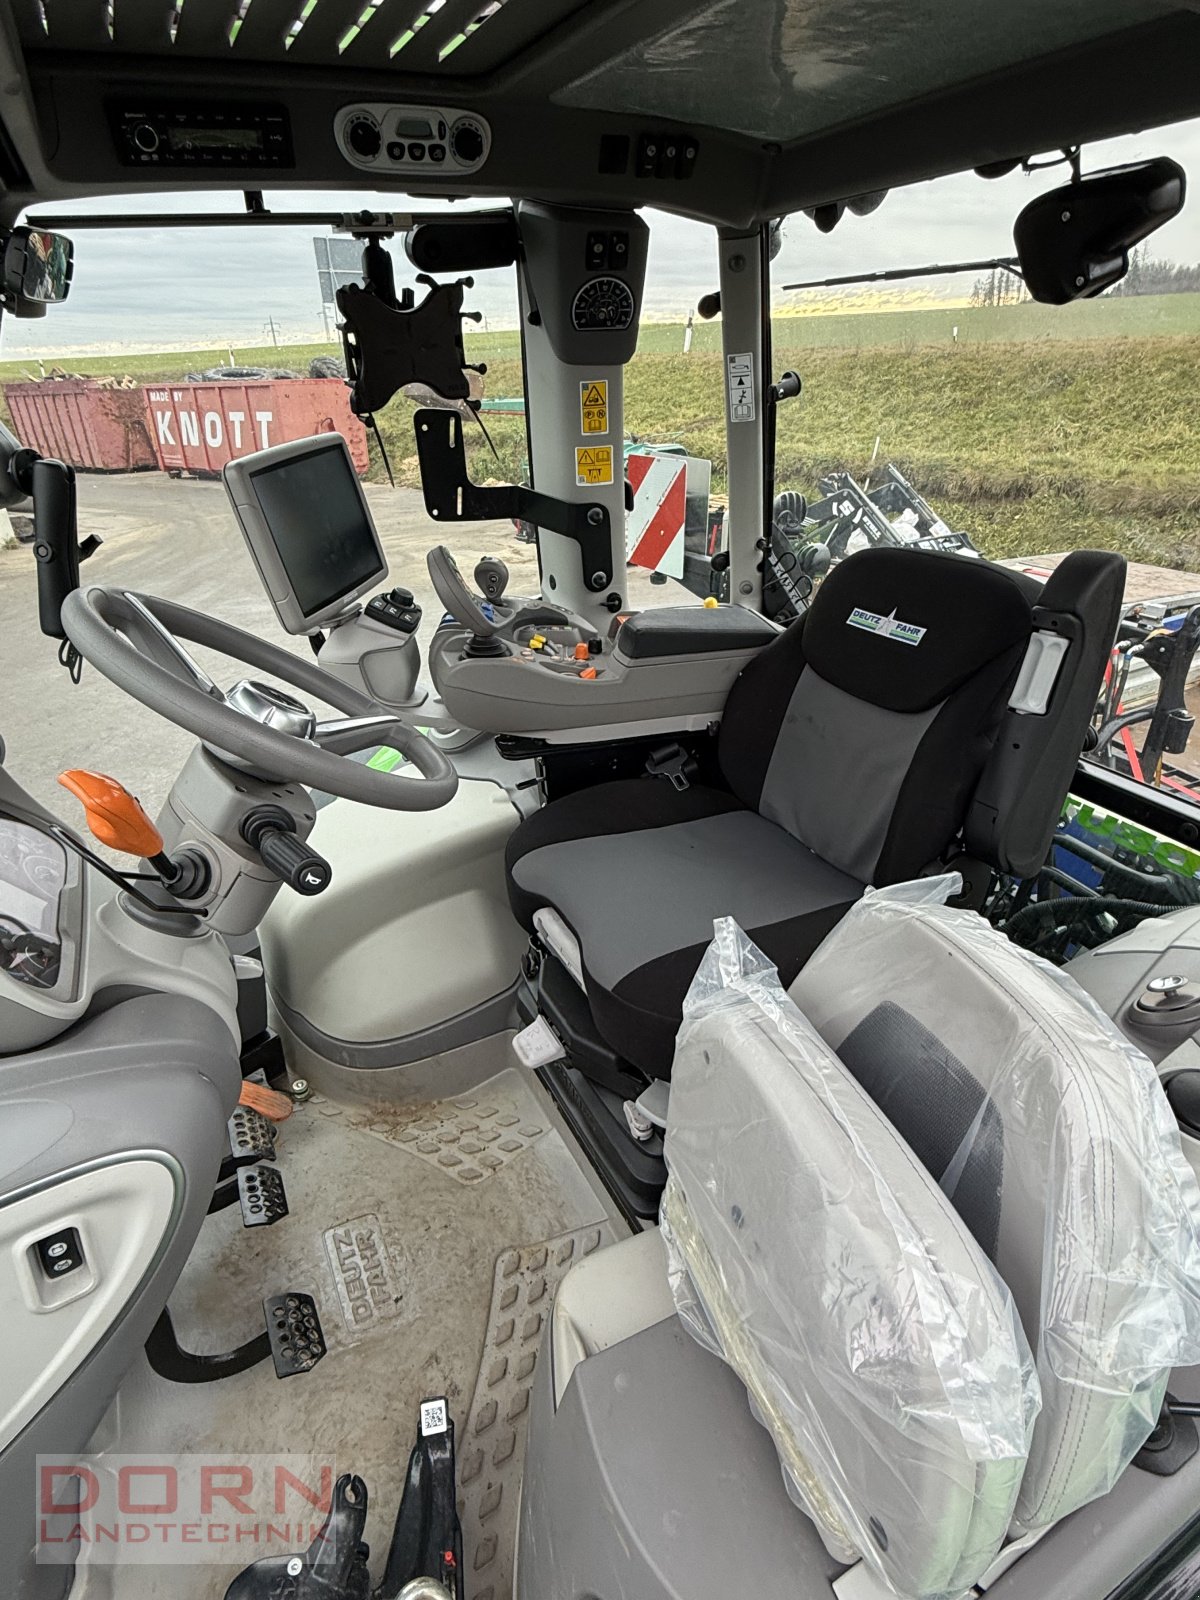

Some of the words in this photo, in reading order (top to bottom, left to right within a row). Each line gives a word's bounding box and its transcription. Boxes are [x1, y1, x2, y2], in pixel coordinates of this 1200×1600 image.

[150, 391, 169, 402] MADE
[173, 391, 183, 402] BY
[156, 411, 273, 449] KNOTT
[853, 610, 882, 624] DEUTZ
[895, 623, 921, 636] FAHR
[333, 1228, 373, 1325] DEUTZ
[355, 1229, 391, 1307] FAHR
